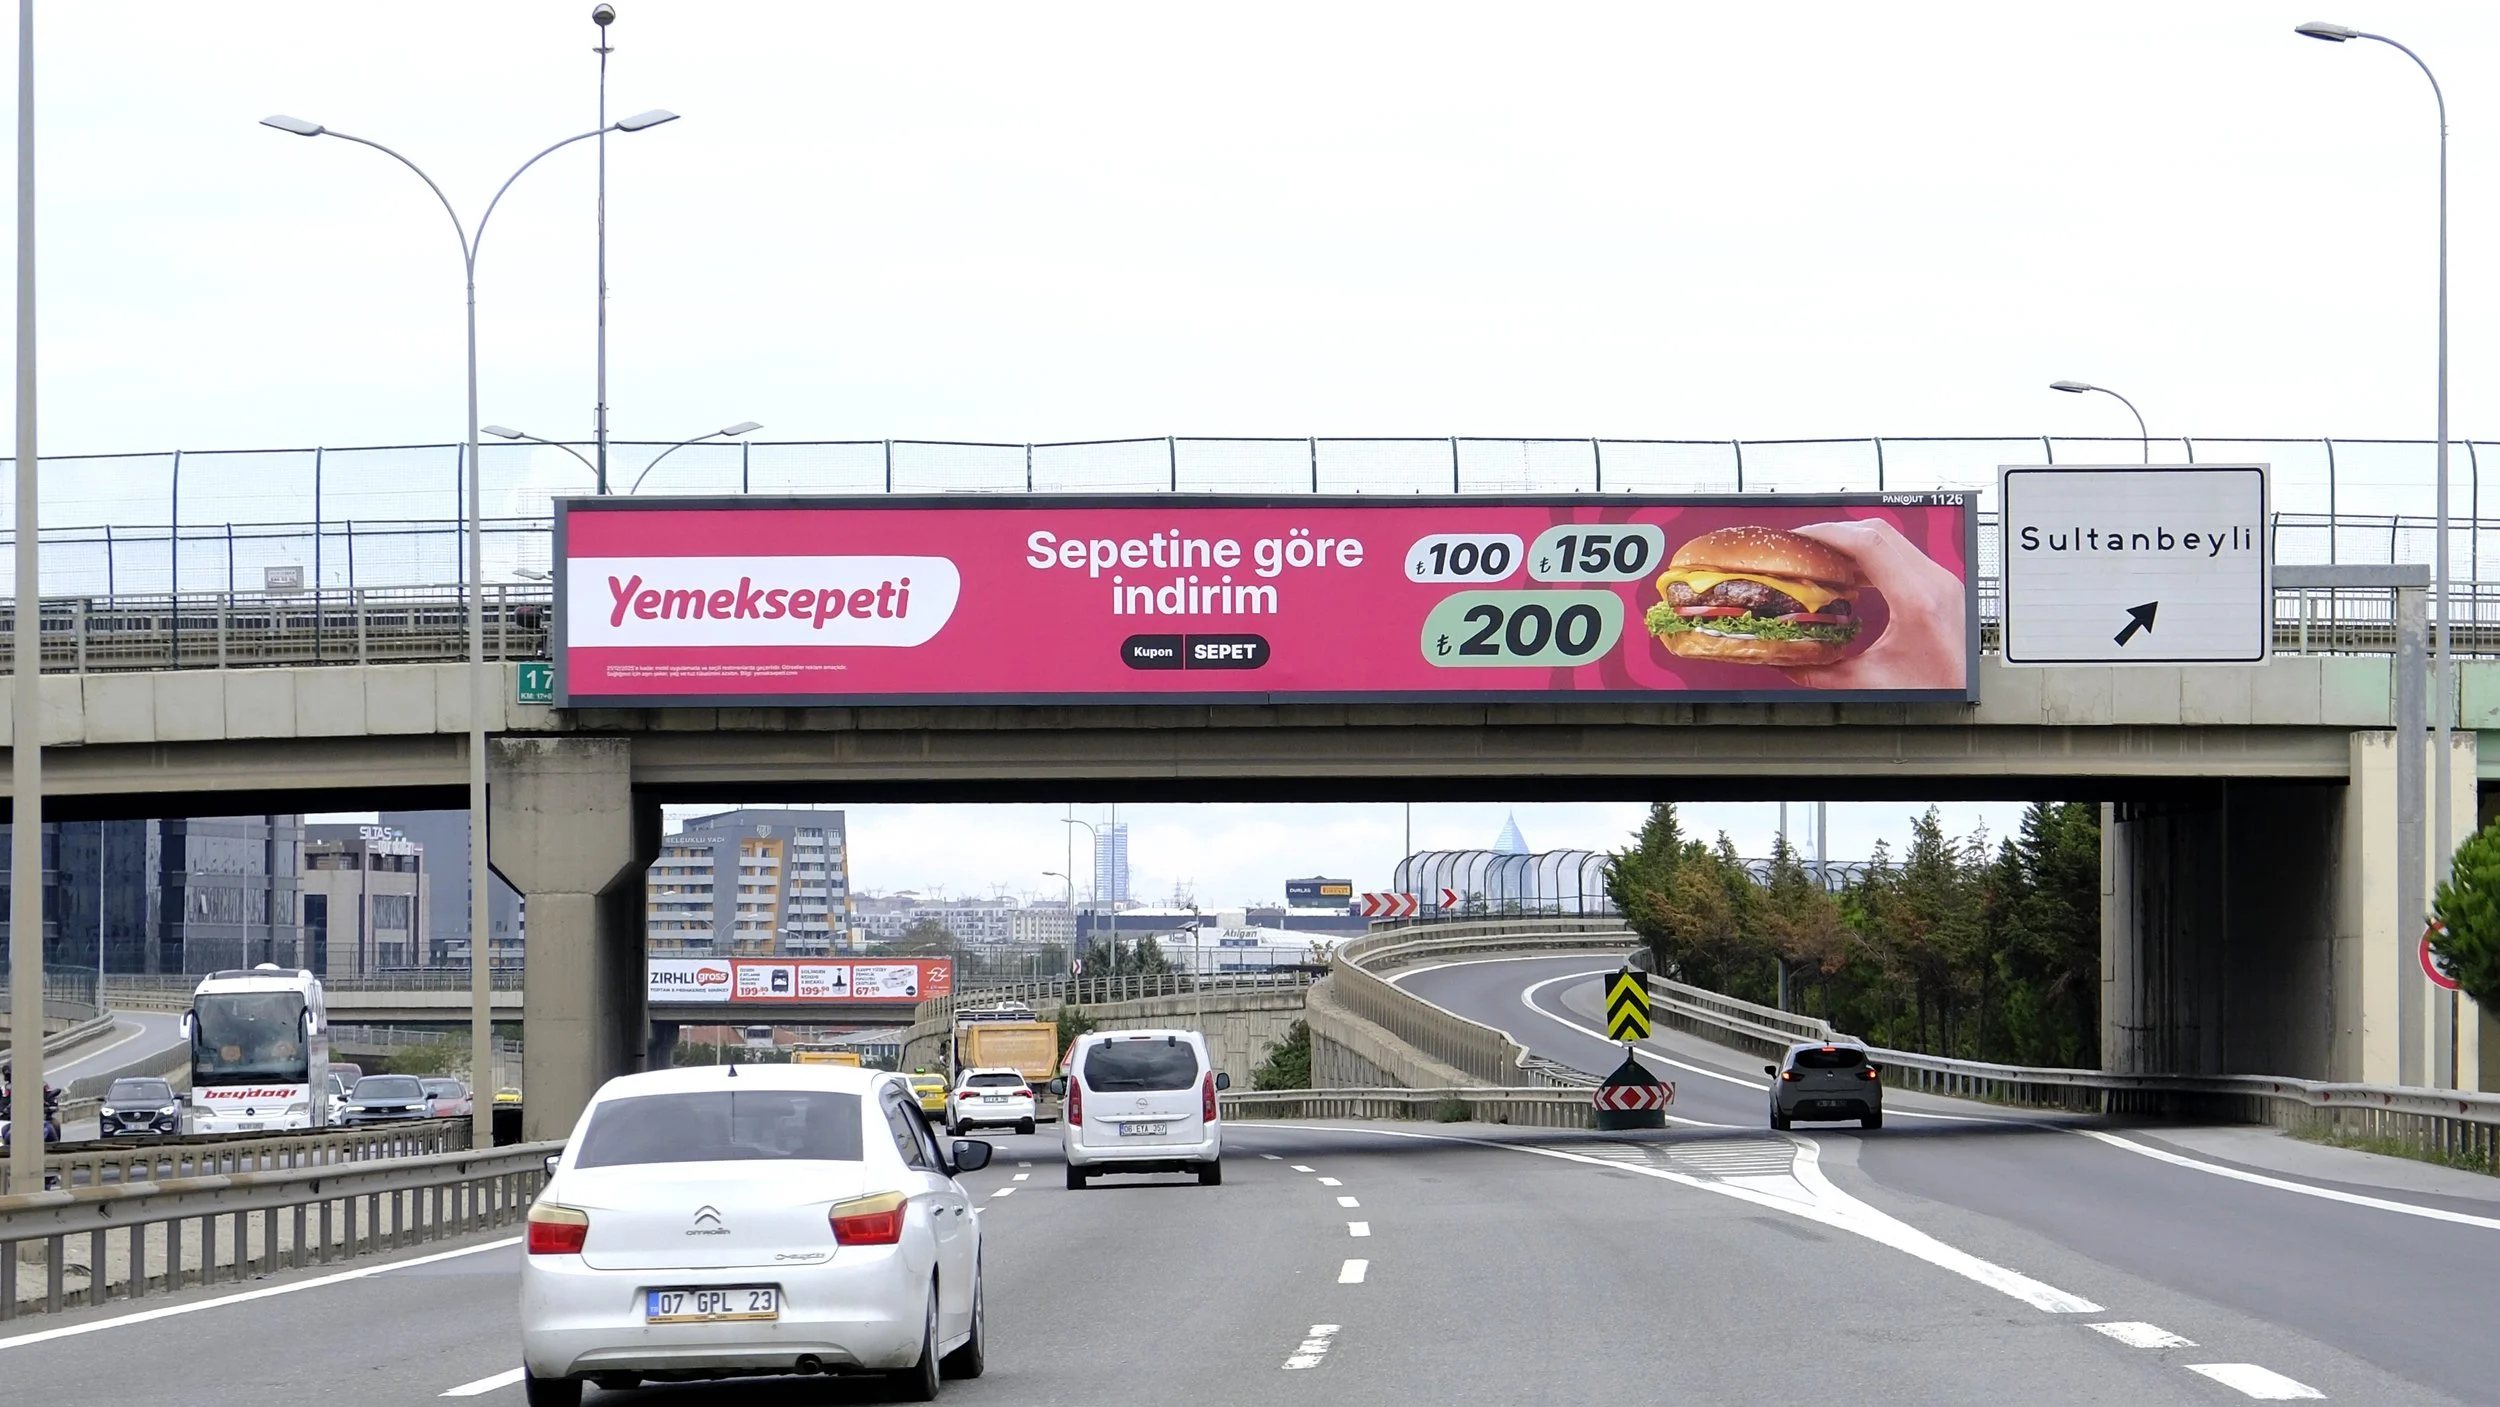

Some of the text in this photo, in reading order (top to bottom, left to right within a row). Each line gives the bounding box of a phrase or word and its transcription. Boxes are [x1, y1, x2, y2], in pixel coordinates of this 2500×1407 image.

[1931, 493, 1963, 505] 1126
[1026, 527, 1364, 578] Sepetine göre
[2020, 525, 2252, 558] Sultanbeyli
[607, 574, 911, 630] Yemeksepeti
[1112, 575, 1279, 615] indirim
[1133, 643, 1257, 660] Kupon SEPET
[526, 670, 554, 689] 17
[650, 972, 694, 984] ZIRHLI
[661, 1291, 772, 1315] 07 GPL 23
